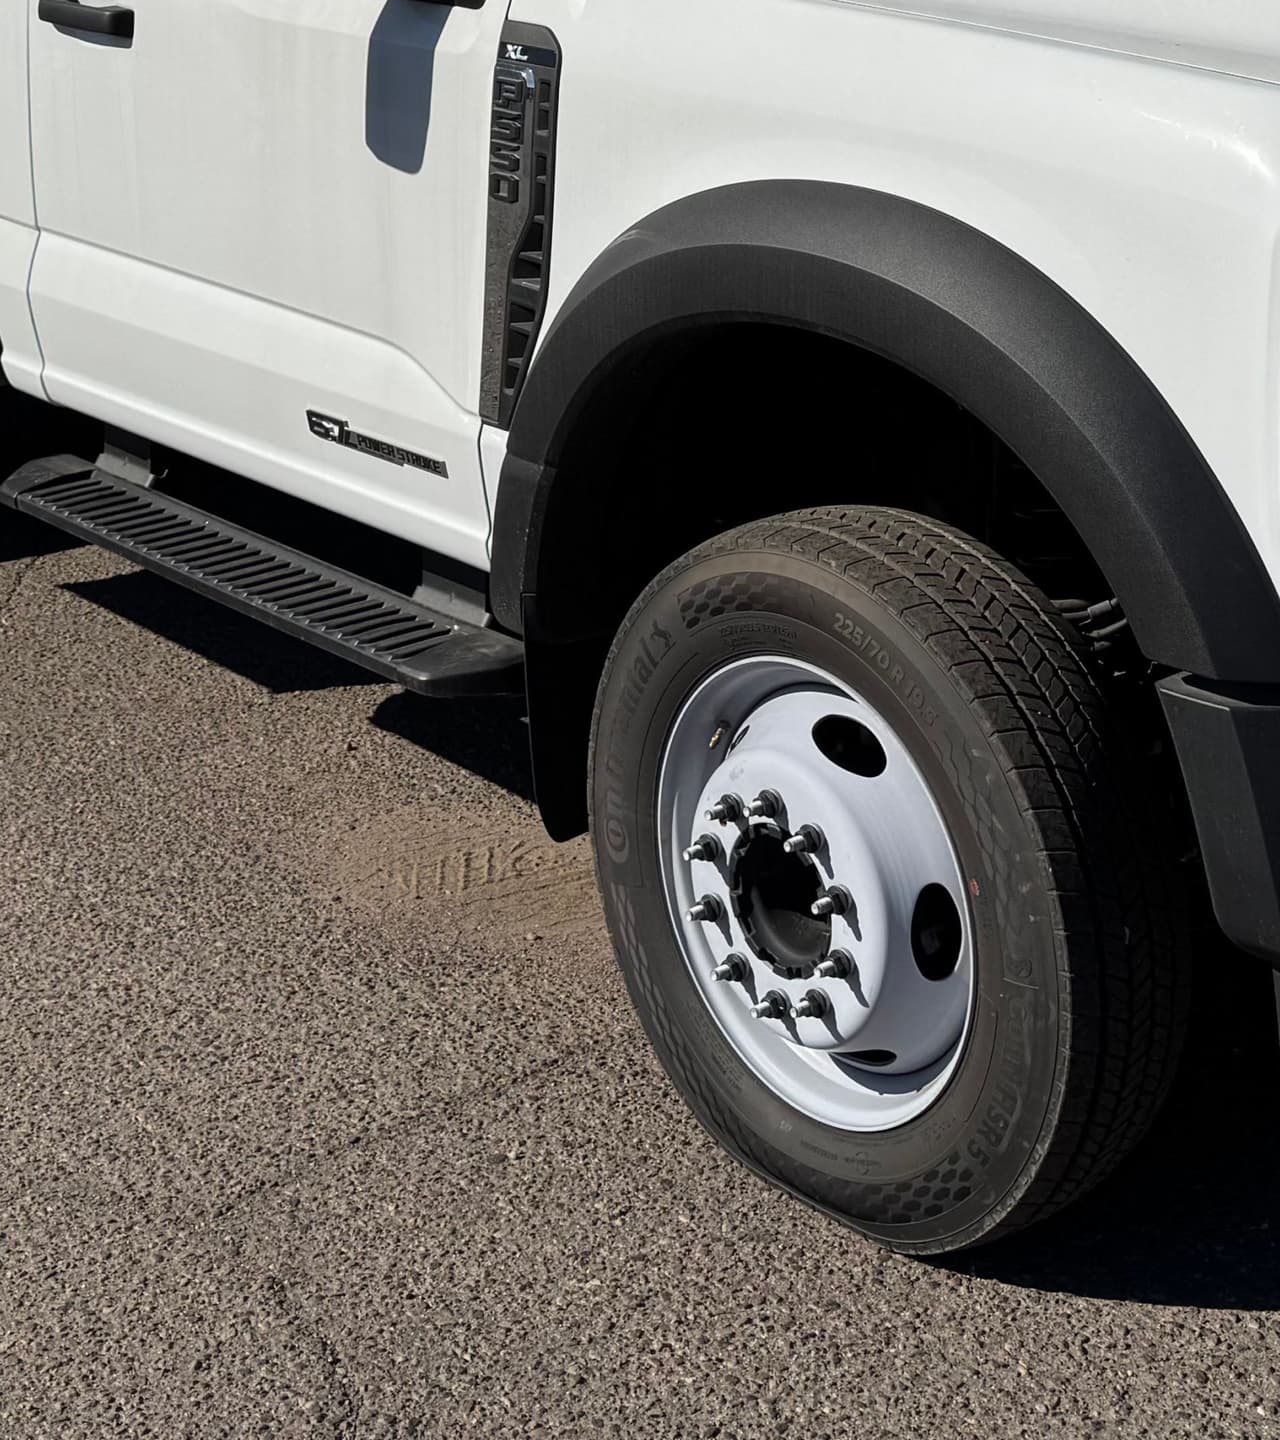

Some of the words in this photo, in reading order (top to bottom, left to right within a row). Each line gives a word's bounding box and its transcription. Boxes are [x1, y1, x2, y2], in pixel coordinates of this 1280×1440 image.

[505, 44, 528, 60] XL
[356, 433, 397, 459] POWER
[395, 449, 443, 474] STROKE
[831, 611, 891, 670] 225/70
[888, 669, 907, 688] R
